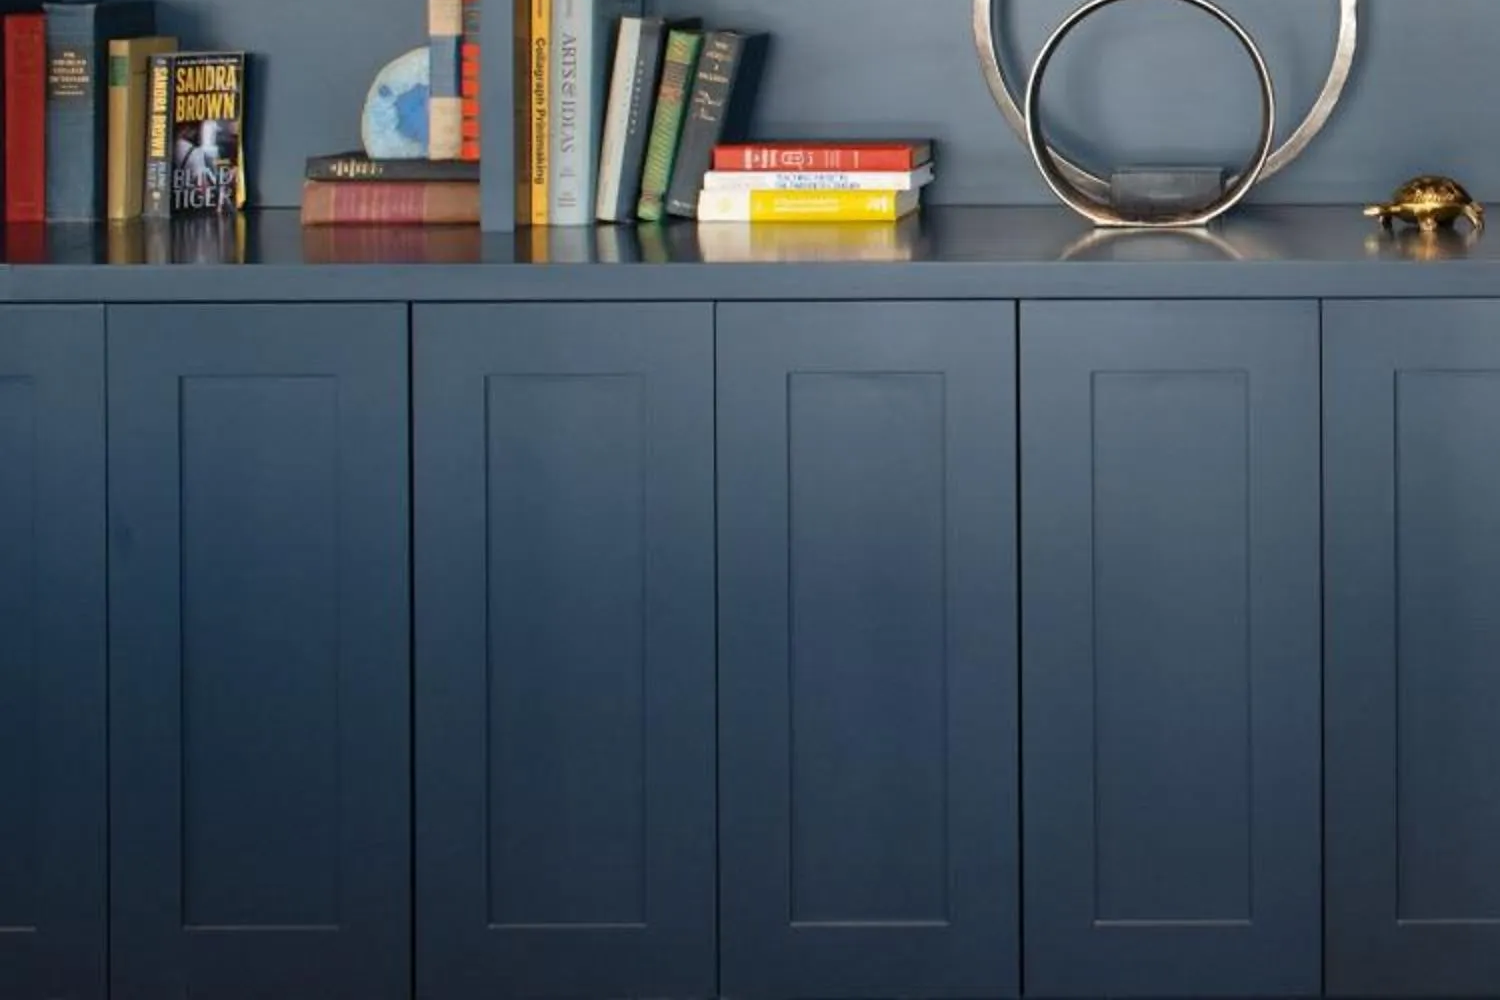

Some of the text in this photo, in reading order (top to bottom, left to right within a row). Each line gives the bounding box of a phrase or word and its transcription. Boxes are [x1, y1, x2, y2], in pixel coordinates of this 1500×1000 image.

[561, 32, 577, 79] ARTS
[153, 66, 168, 111] SANDRA
[175, 65, 237, 93] SANDRA
[175, 92, 235, 123] BROWN
[150, 115, 166, 157] BROWN
[533, 108, 547, 185] Printmaking
[173, 167, 234, 189] BLIND
[174, 187, 234, 213] TIGER
